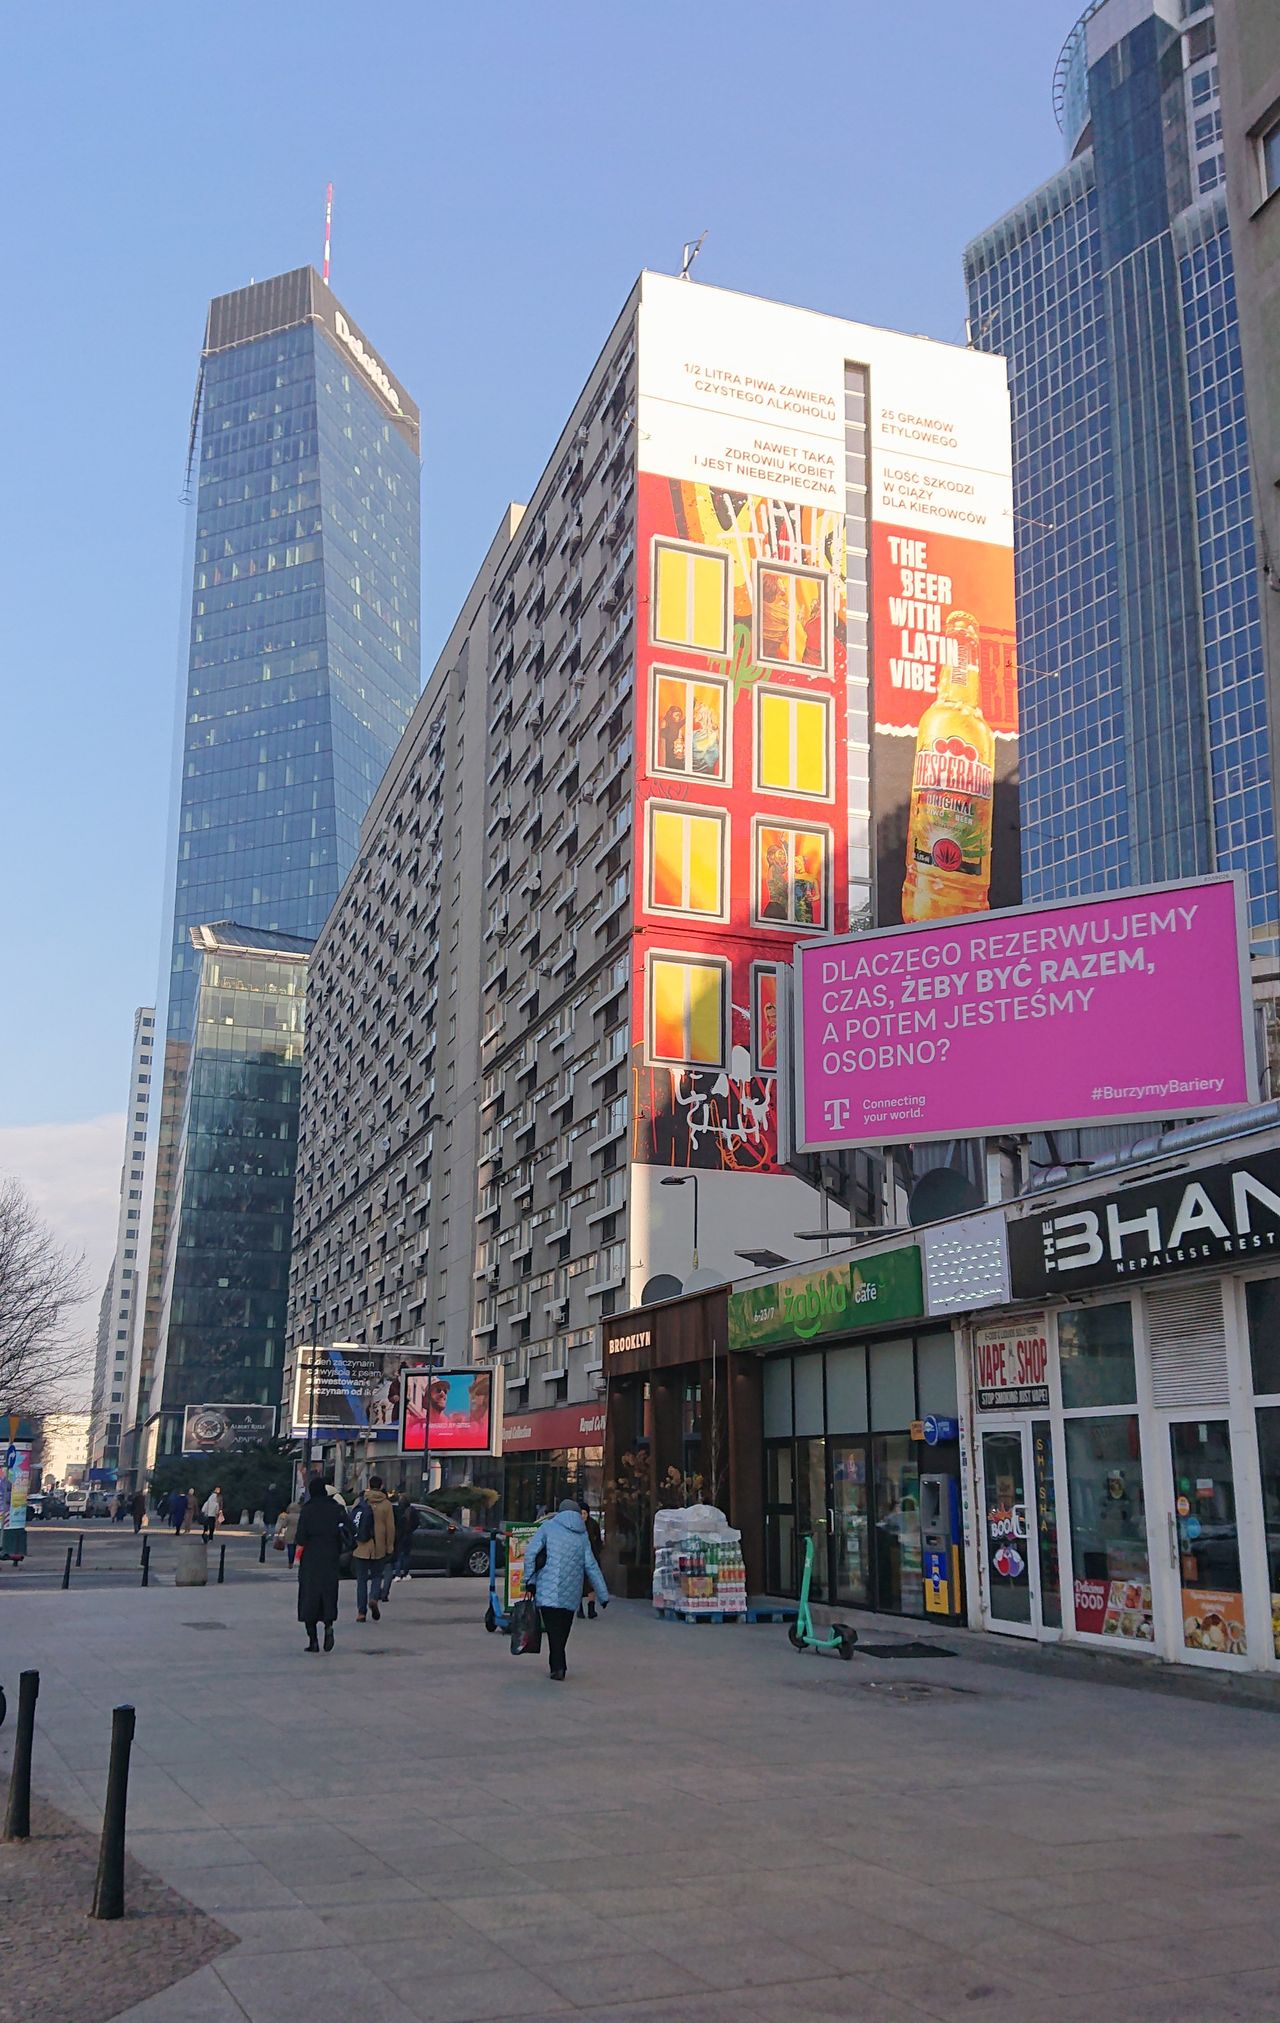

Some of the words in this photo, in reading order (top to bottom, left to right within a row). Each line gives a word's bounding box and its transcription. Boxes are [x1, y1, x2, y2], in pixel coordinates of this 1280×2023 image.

[684, 363, 701, 376] 1/2
[705, 367, 741, 385] LITRA
[745, 377, 776, 394] PIWA
[779, 385, 836, 407] ZAWIERA
[881, 408, 895, 420] 25
[695, 380, 764, 405] CZYSTEGO
[767, 397, 836, 421] ALKOHOLU
[881, 423, 958, 448] ETYLOWEGO
[725, 447, 785, 469] ZDROWIU
[789, 461, 835, 480] KOBIET
[883, 482, 895, 493] W
[753, 439, 798, 458] NAWET
[802, 449, 835, 466] TAKA
[883, 467, 920, 484] ILOŚĆ
[923, 476, 975, 495] SZKODZI
[701, 459, 733, 473] JEST
[736, 464, 837, 495] NIEBEZPIECZNA
[882, 496, 907, 510] DLA
[910, 501, 987, 526] KIEROWCÓW
[888, 535, 928, 570] THE
[900, 568, 952, 605] BEER
[889, 596, 942, 633] WITH
[901, 629, 959, 667] LATIN
[926, 792, 974, 816] ORIGINAL
[822, 942, 961, 984] DLACZEGO
[970, 904, 1199, 962] REZERWUJEMY
[822, 984, 895, 1014] CZAS,
[901, 973, 969, 1004] ŻEBY
[976, 957, 1033, 993] BYĆ
[1040, 947, 1156, 984] RAZEM,
[822, 1022, 839, 1045] A
[846, 1008, 937, 1042] POTEM
[944, 987, 1095, 1029] JESTEŚMY
[822, 1038, 950, 1075] OSOBNO?
[863, 1095, 926, 1110] Connecting
[1091, 1078, 1225, 1100] #BurzymyBariery
[863, 1112, 888, 1125] your
[890, 1108, 924, 1120] world.
[1042, 1219, 1057, 1274] THE
[1116, 1244, 1210, 1273] NEPALESE
[609, 1331, 651, 1354] BROOKLYN
[978, 1343, 1007, 1387] VAPE
[1017, 1338, 1047, 1384] SHOP
[305, 1387, 349, 1396] zczynam
[981, 1392, 995, 1405] STOP
[1019, 1389, 1031, 1403] JUST
[579, 1417, 594, 1435] Royal
[1036, 1439, 1048, 1531] SHISHA
[1075, 1593, 1104, 1610] FOOD
